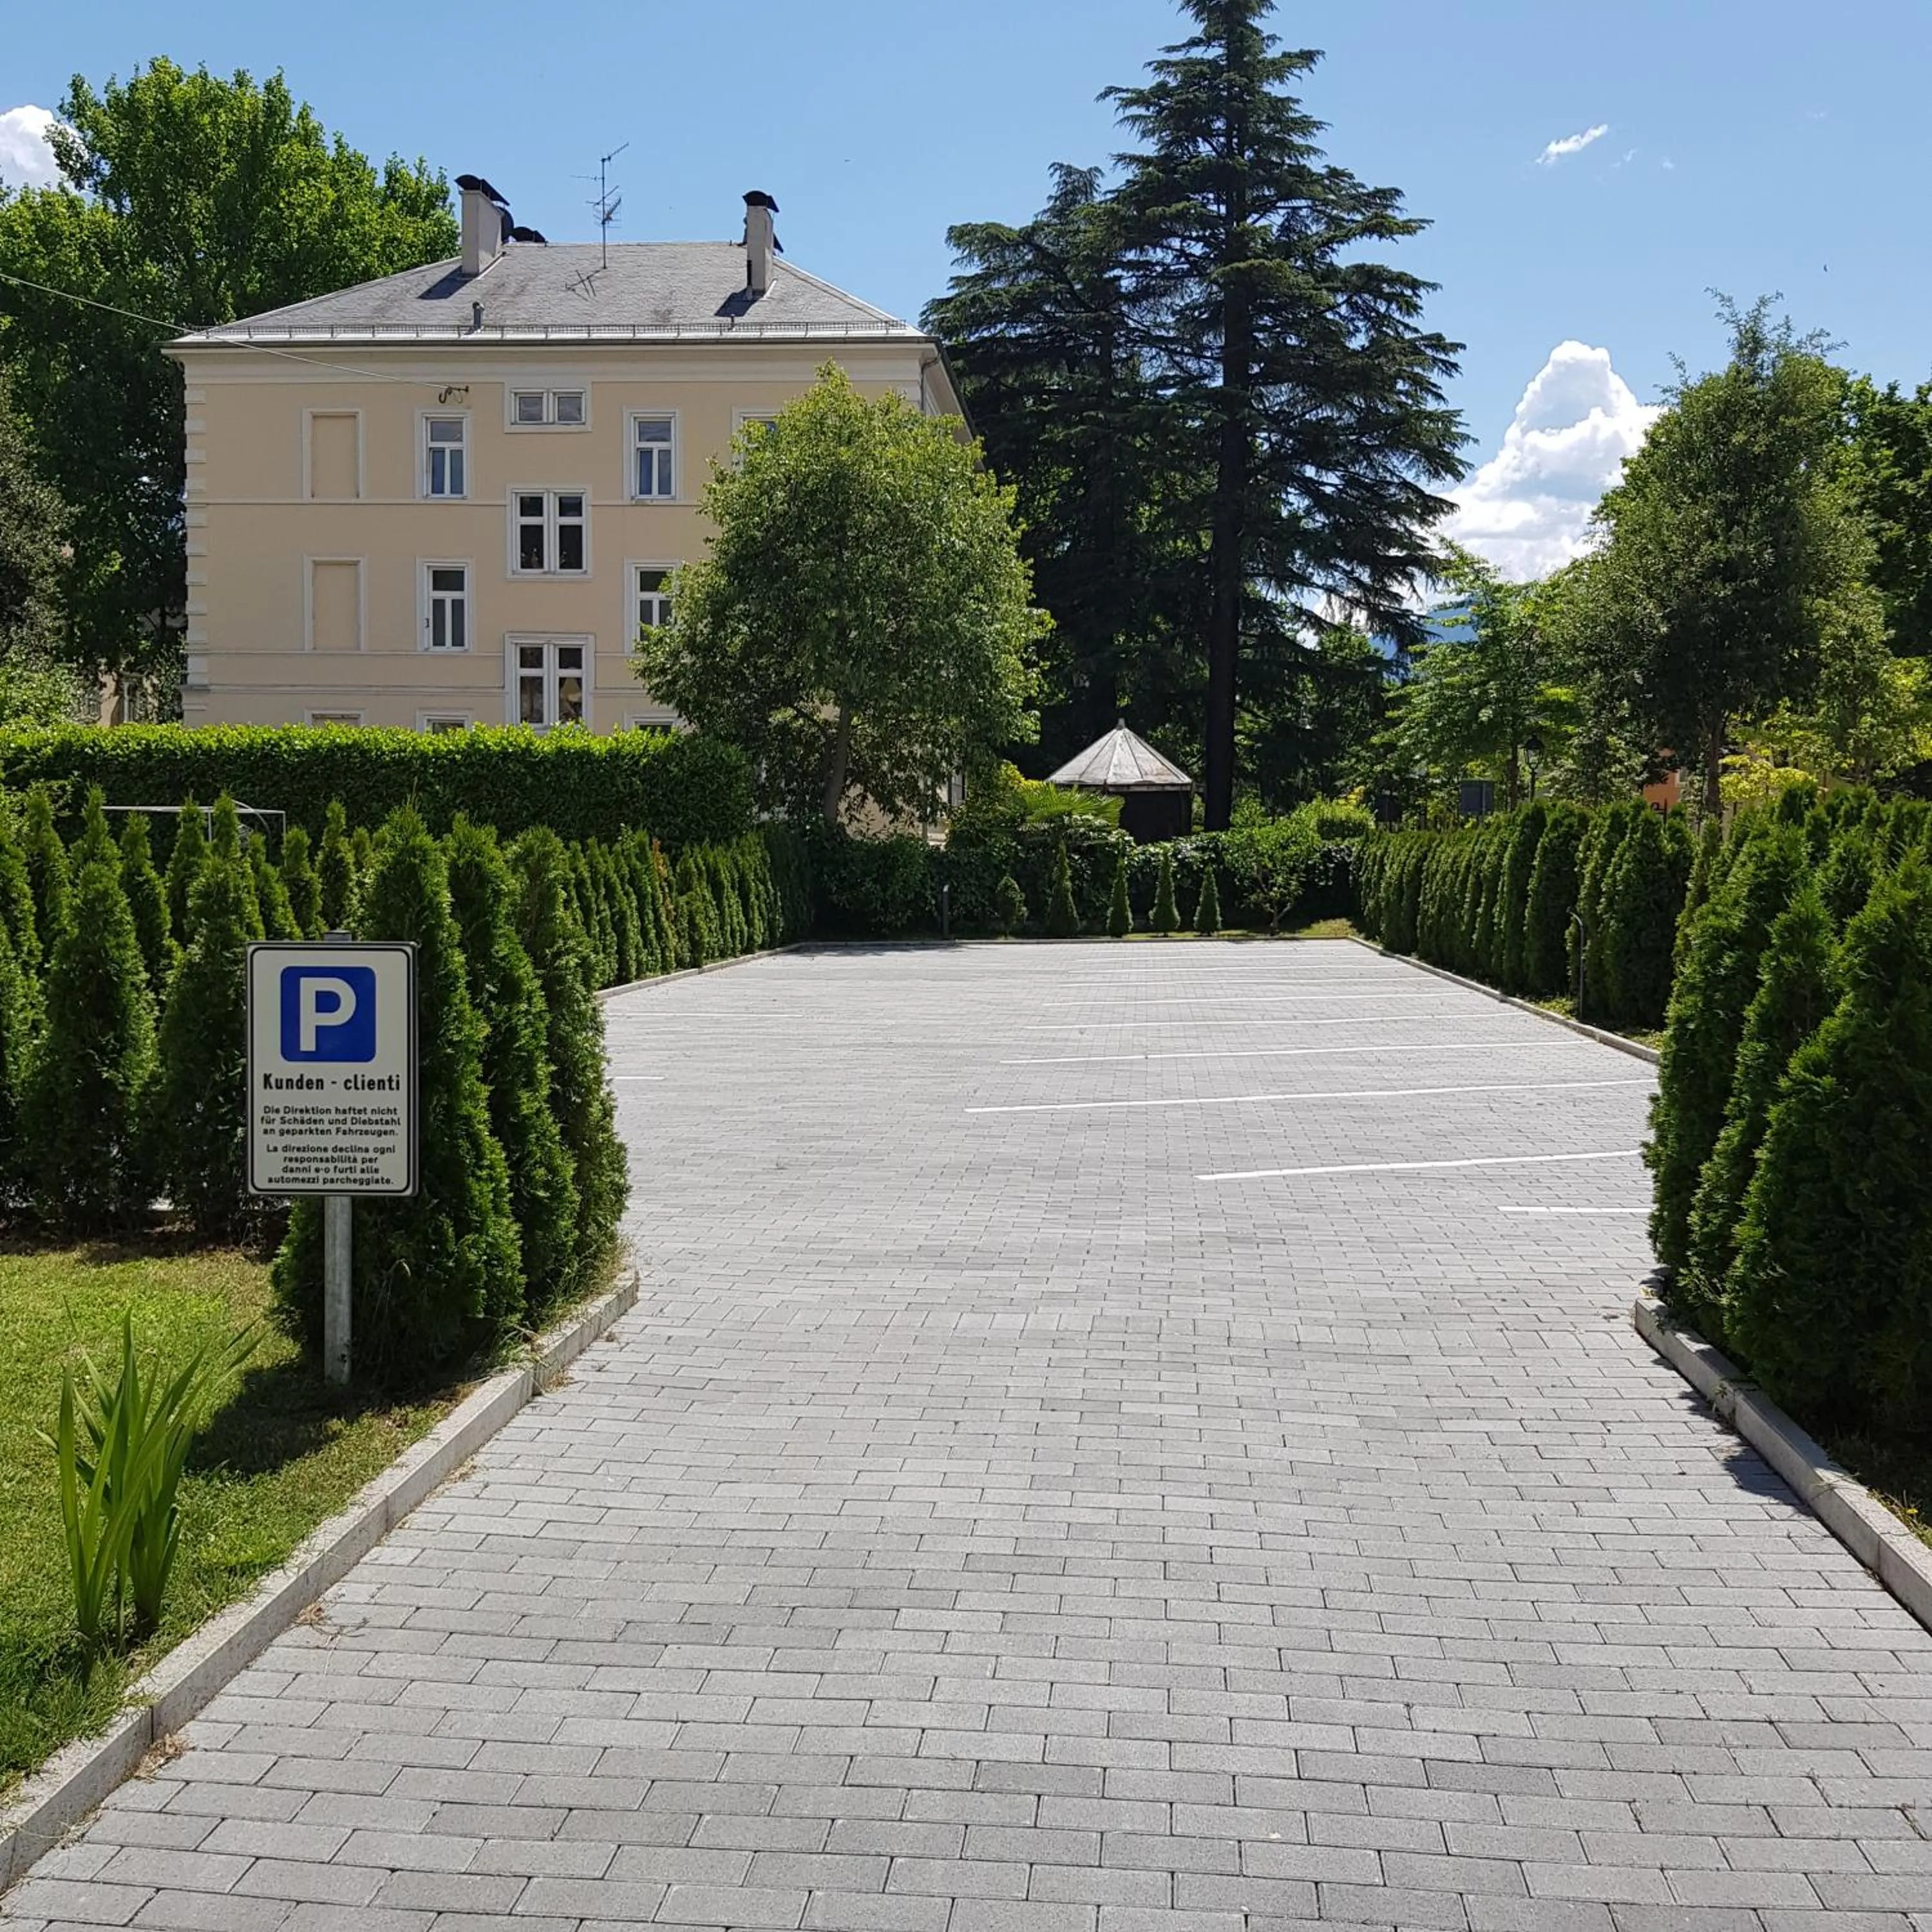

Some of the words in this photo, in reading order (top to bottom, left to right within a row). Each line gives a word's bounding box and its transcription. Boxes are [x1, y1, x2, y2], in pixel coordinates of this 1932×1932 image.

[299, 977, 357, 1052] P
[263, 1074, 324, 1090] Kunden
[344, 1074, 400, 1090] clienti
[263, 1106, 280, 1114] Die
[283, 1106, 332, 1114] Direktion
[335, 1106, 367, 1115] haftet
[351, 1117, 401, 1126] Diebstahl
[279, 1128, 332, 1137] geparkten
[335, 1128, 399, 1137] Fahrzeugen.
[281, 1144, 328, 1153] direzione
[373, 1145, 395, 1154] ogni
[283, 1155, 357, 1165] responsabilità
[323, 1177, 394, 1185] parcheggiate.
